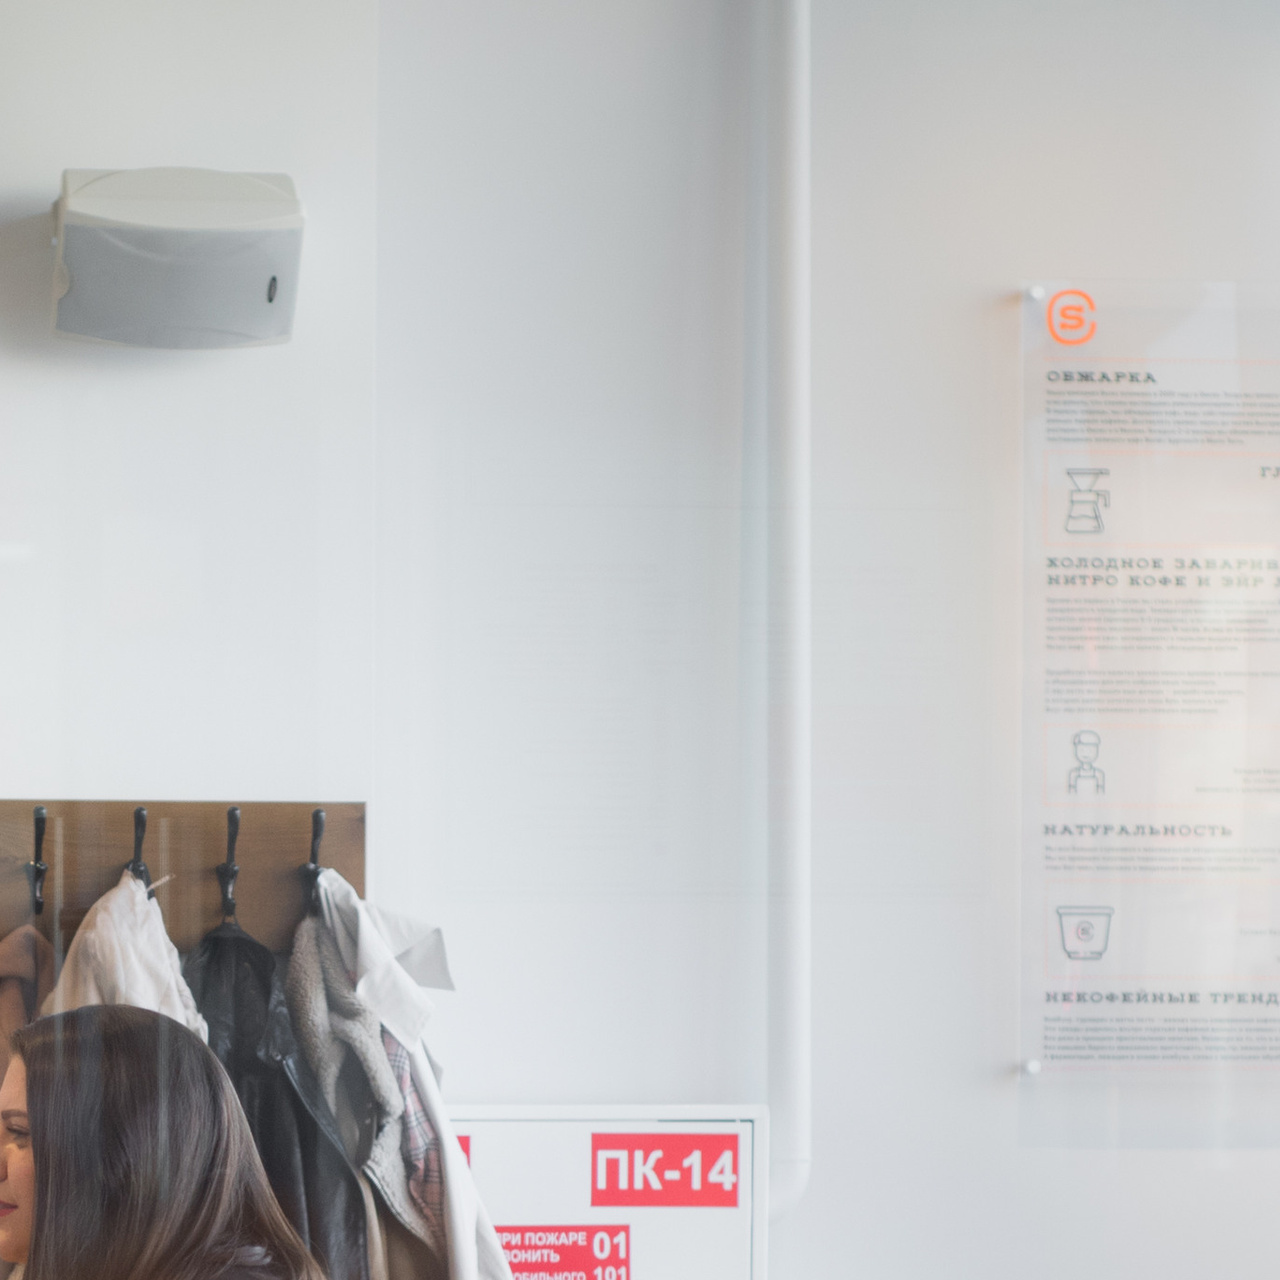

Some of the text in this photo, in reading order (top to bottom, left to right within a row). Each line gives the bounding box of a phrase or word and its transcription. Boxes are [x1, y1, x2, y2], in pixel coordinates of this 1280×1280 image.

[1046, 557, 1164, 572] ХОЛОДНОЕ
[1046, 574, 1119, 587] НИТРО
[1129, 575, 1188, 588] КОФЕ
[1043, 824, 1233, 837] НАТУРАЛЬНОСТЬ
[1045, 989, 1201, 1004] НЕКОФЕЙНЫЕ
[596, 1149, 737, 1191] ПК-14
[524, 1232, 587, 1246] ПОЖАРЕ
[593, 1231, 626, 1260] 01
[504, 1249, 560, 1263] ВОНИТЬ
